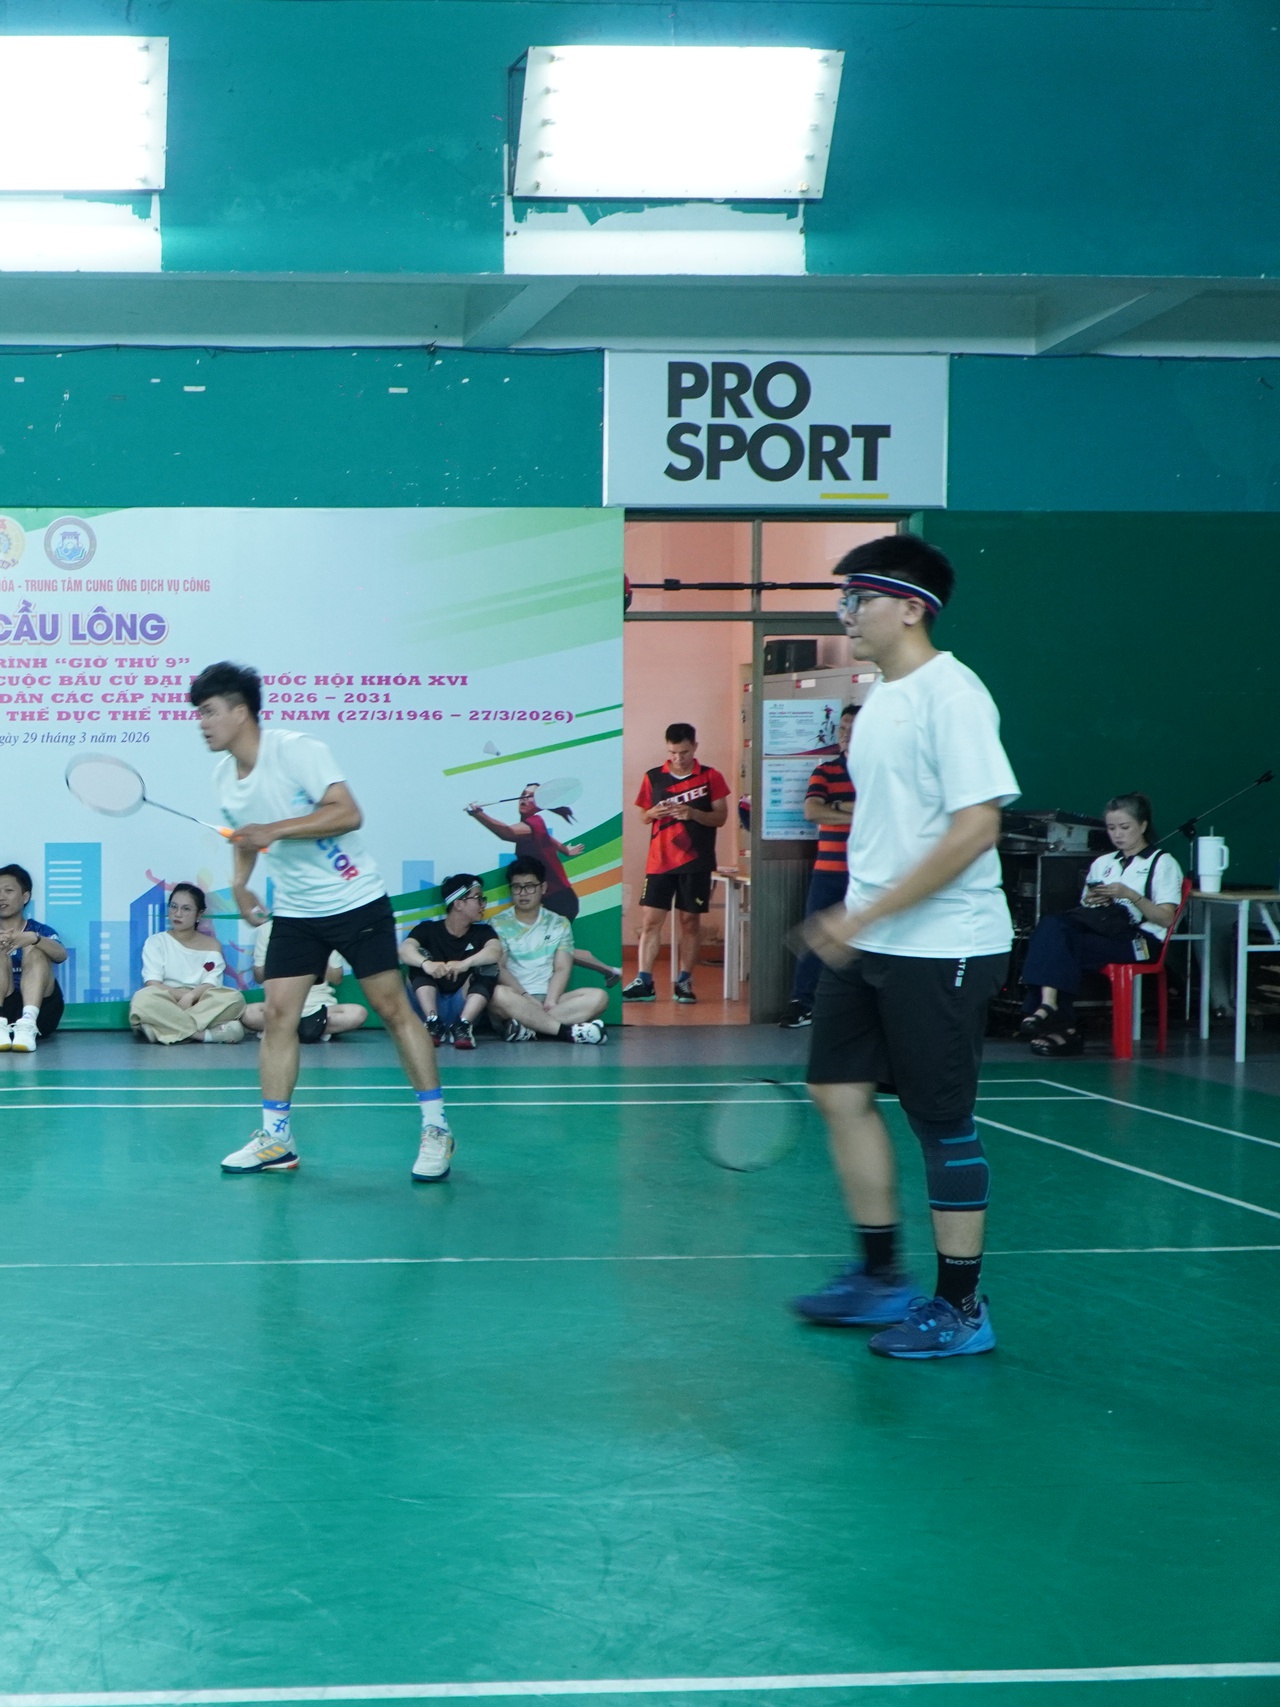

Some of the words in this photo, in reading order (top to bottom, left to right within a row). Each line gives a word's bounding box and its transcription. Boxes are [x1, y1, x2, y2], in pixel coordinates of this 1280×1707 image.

[667, 361, 811, 420] PRO
[663, 422, 891, 482] SPORT
[25, 580, 58, 592] TRUNG
[61, 577, 82, 592] TÂM
[86, 580, 113, 592] CUNG
[117, 577, 137, 592] ỨNG
[140, 579, 164, 595] DỊCH
[167, 579, 180, 595] VỤ
[183, 577, 210, 592] CÔNG
[72, 606, 167, 642] LÔNG
[115, 656, 159, 668] THỨ
[144, 675, 182, 688] ĐẠI
[263, 672, 307, 686] UỐC
[314, 672, 354, 688] HỘI
[361, 672, 422, 686] KHÓA
[428, 675, 468, 686] XVI
[51, 690, 93, 703] CÁC
[101, 688, 145, 703] CẤP
[268, 692, 318, 703] 2026
[343, 692, 391, 703] 2031
[56, 710, 105, 723] DỤC
[158, 710, 202, 721] THA
[280, 710, 330, 721] NAM
[337, 710, 443, 723] (27/3/1946
[469, 710, 574, 723] 27/3/2026)
[22, 732, 38, 744] 29
[40, 731, 76, 746] tháng
[79, 732, 87, 744] 3
[90, 731, 117, 744] năm
[120, 732, 150, 744] 2026
